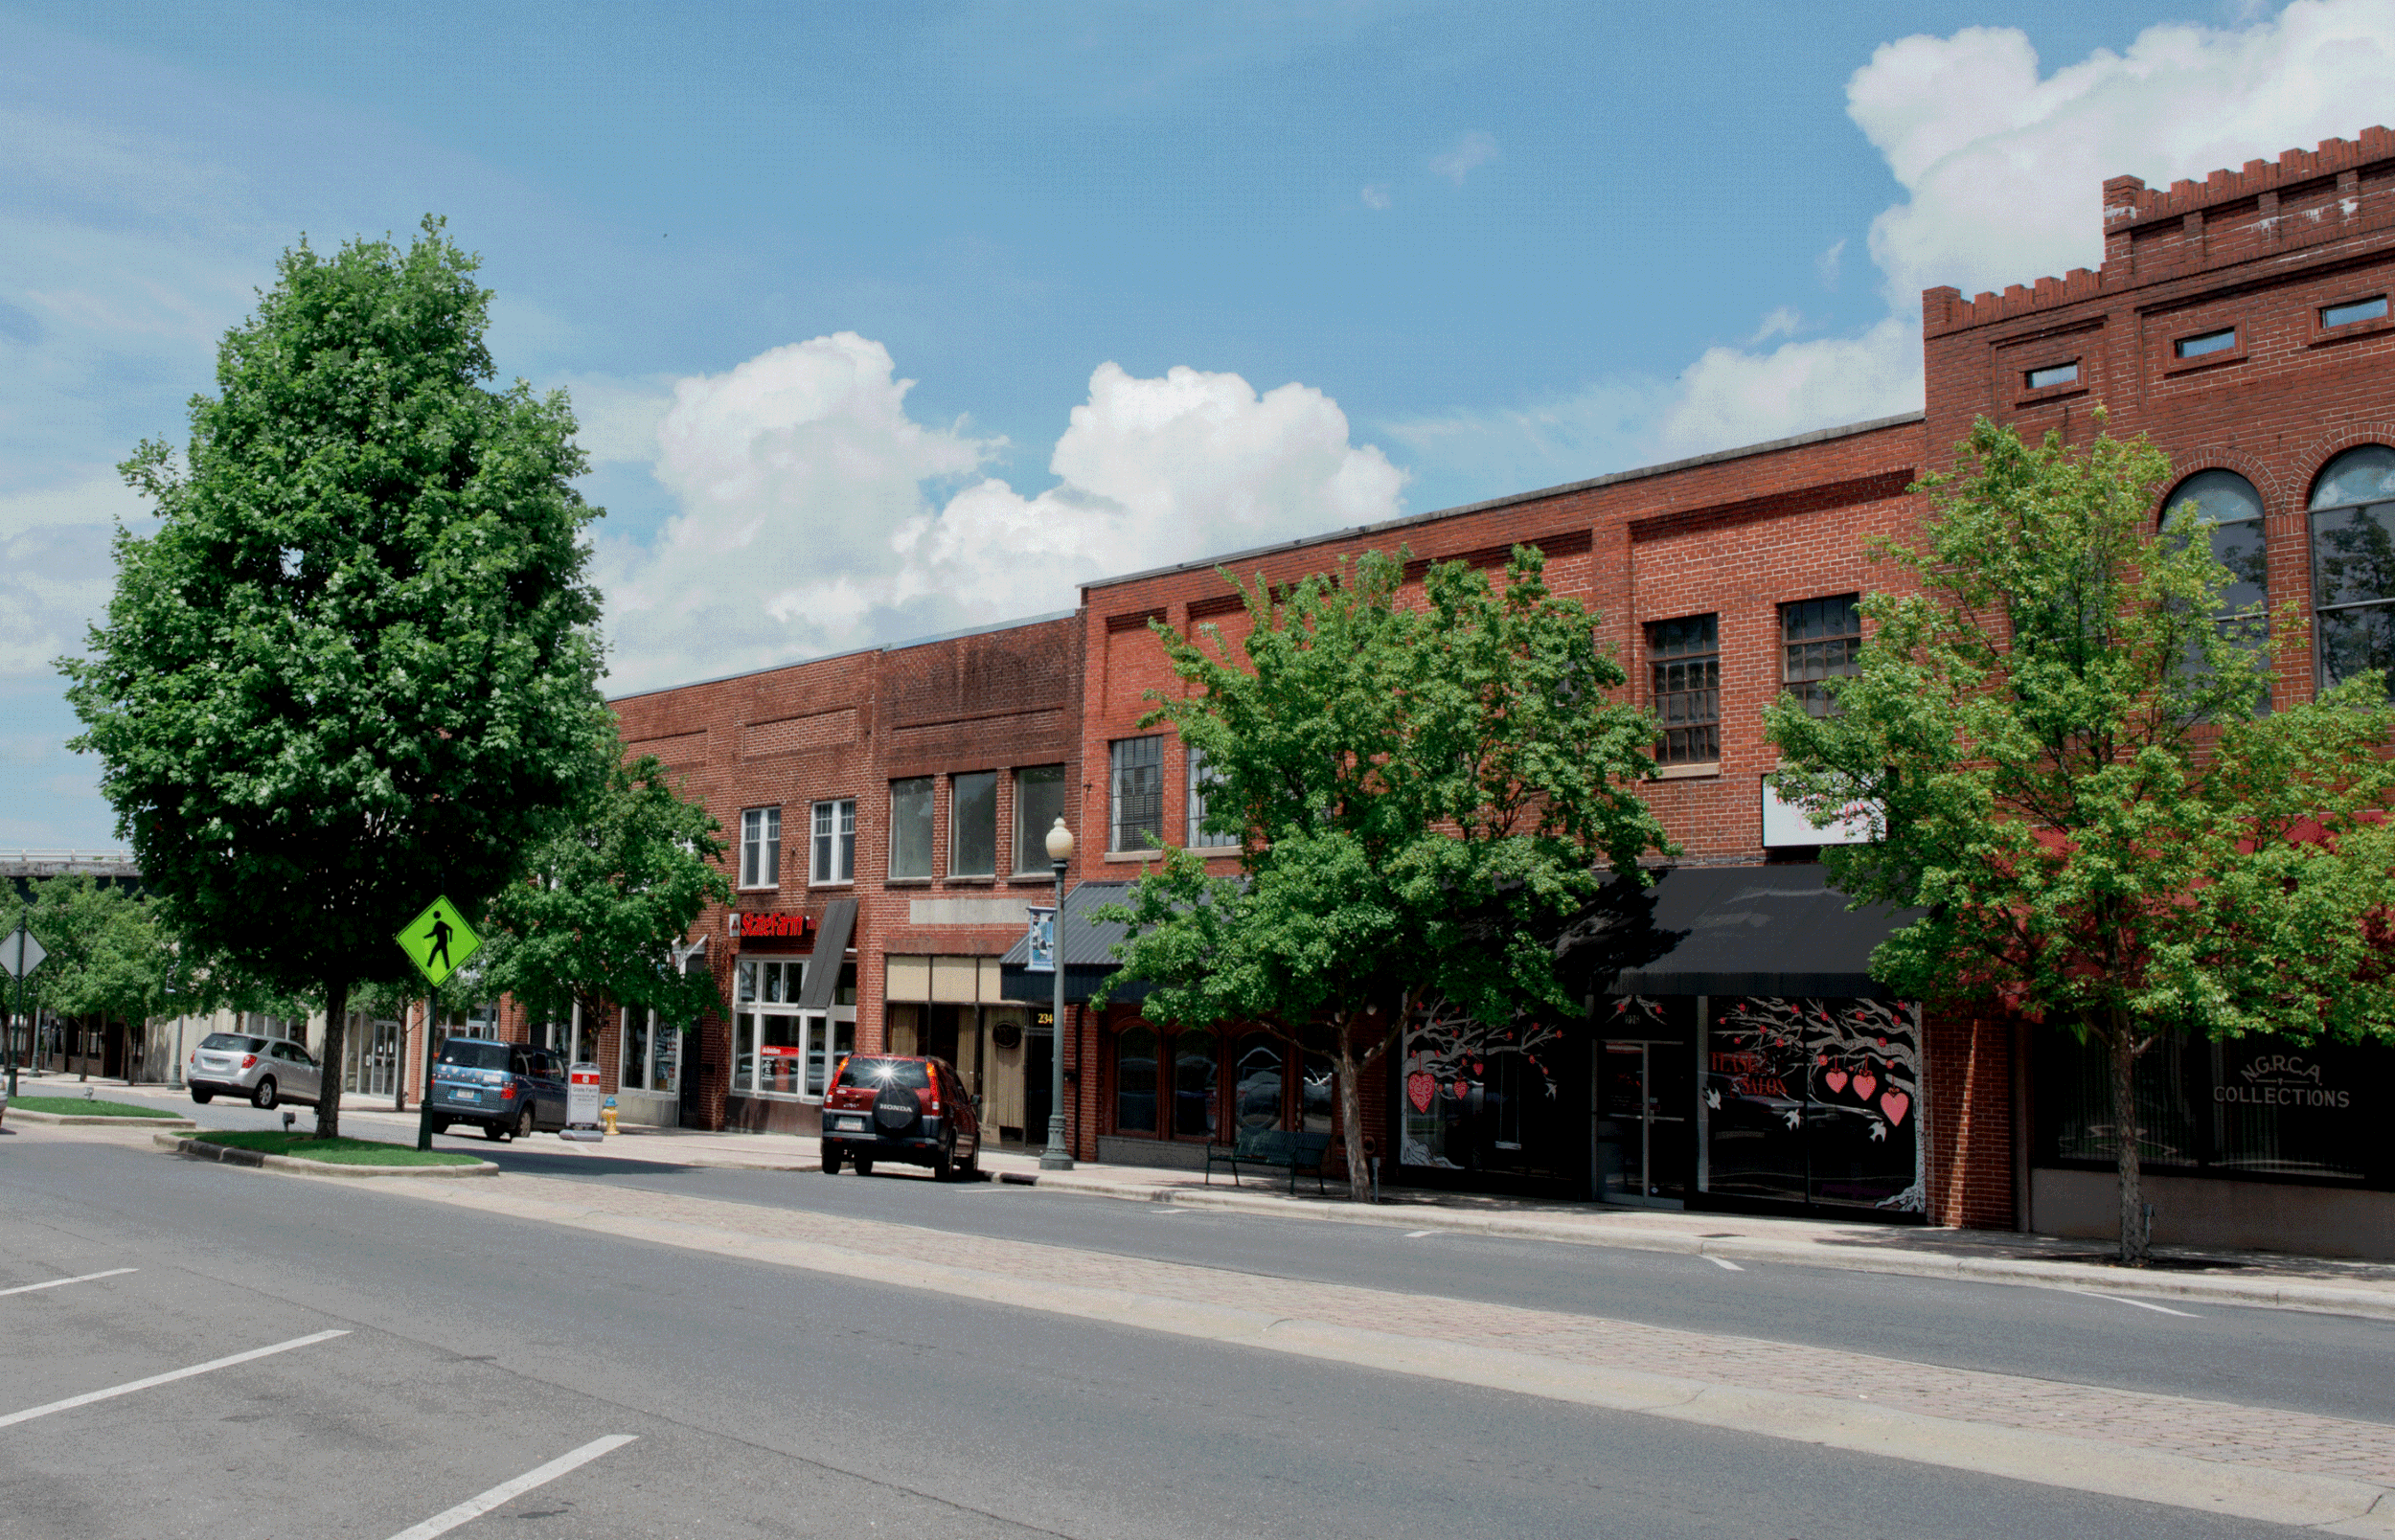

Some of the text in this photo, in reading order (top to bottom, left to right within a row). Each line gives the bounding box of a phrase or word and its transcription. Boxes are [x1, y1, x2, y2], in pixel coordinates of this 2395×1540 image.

[1038, 1012, 1054, 1025] 234
[1731, 1075, 1790, 1098] SALON
[2213, 1085, 2351, 1108] COLLECTIONS
[879, 1102, 913, 1113] HONDA
